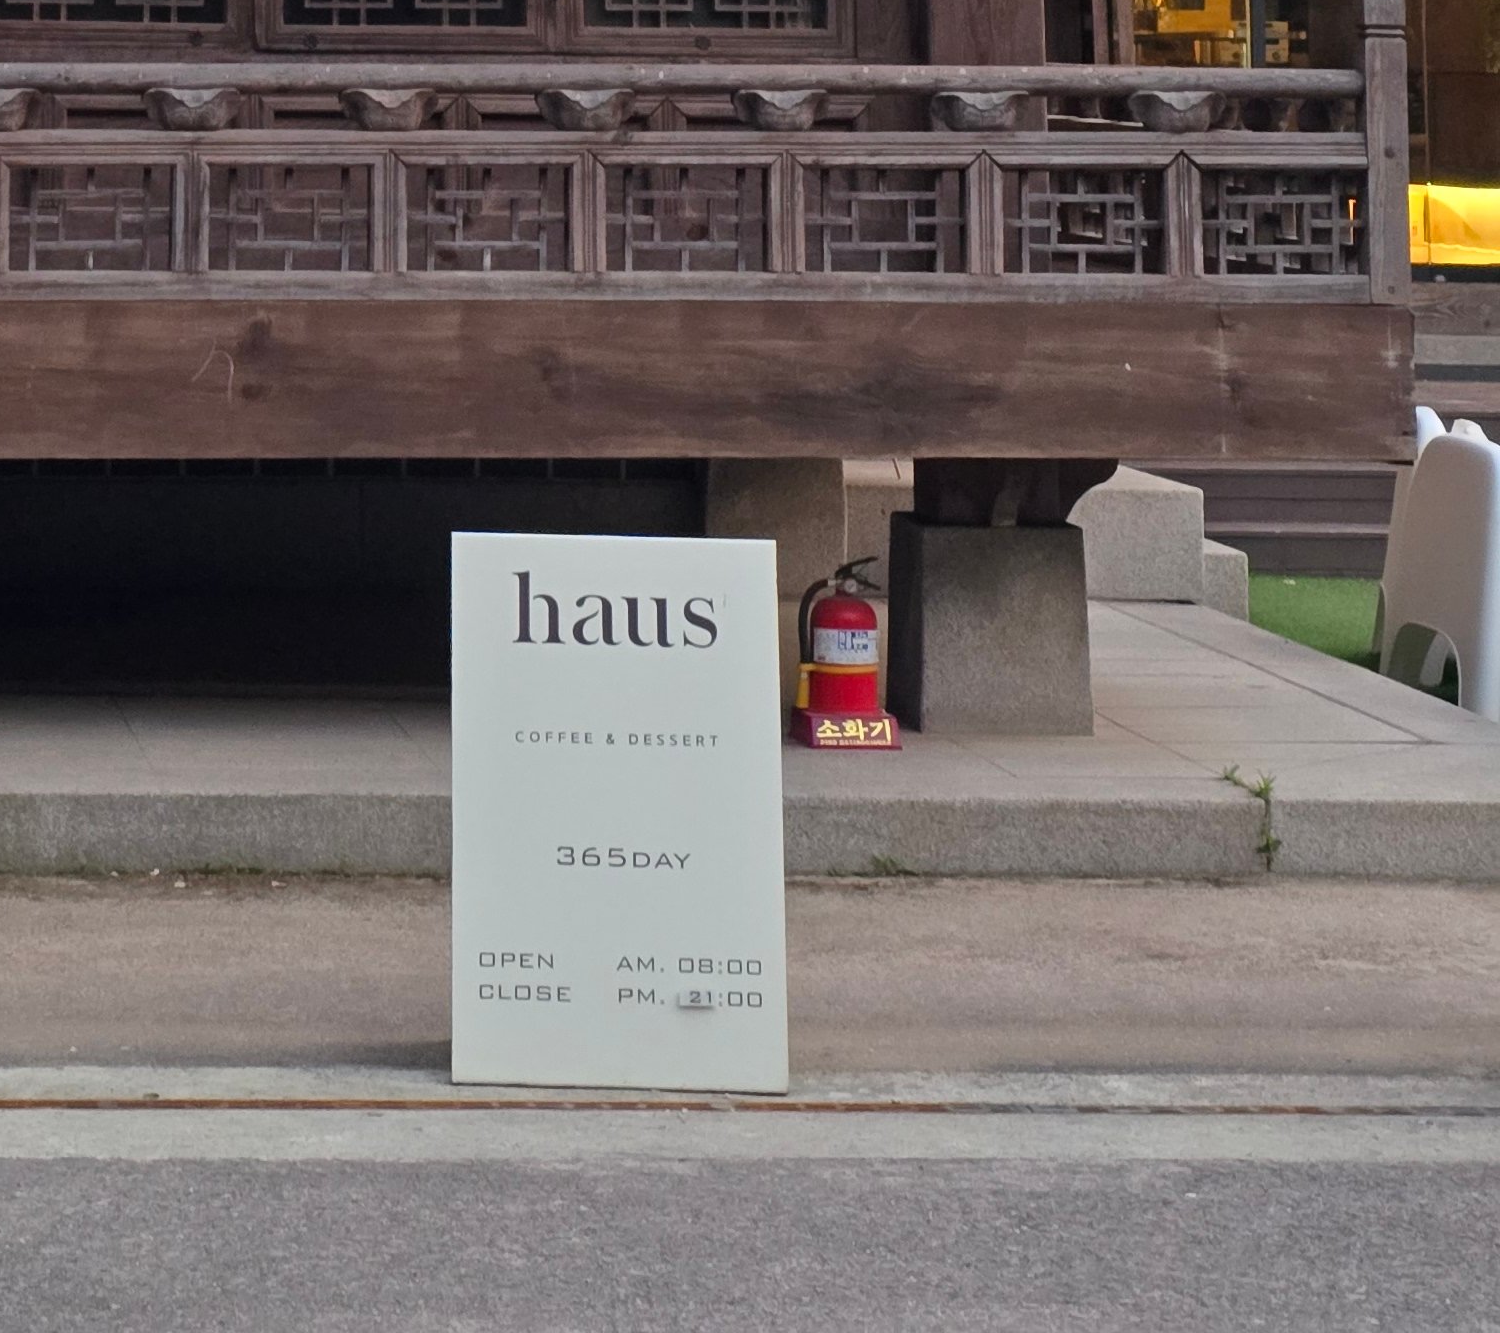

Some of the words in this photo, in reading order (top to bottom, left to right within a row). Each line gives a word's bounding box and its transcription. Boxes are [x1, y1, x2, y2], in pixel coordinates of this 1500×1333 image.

[512, 570, 718, 648] haus
[515, 731, 593, 744] COFFEE
[606, 733, 615, 745] &
[628, 733, 719, 747] DESSERT
[816, 718, 892, 742] 소화기
[557, 846, 691, 869] 365DAY
[479, 952, 554, 969] OPEN
[617, 956, 665, 973] AM.
[678, 958, 762, 975] 08:00
[479, 984, 571, 1002] CLOSE
[618, 988, 665, 1005] PM.
[689, 990, 762, 1007] 21:00
